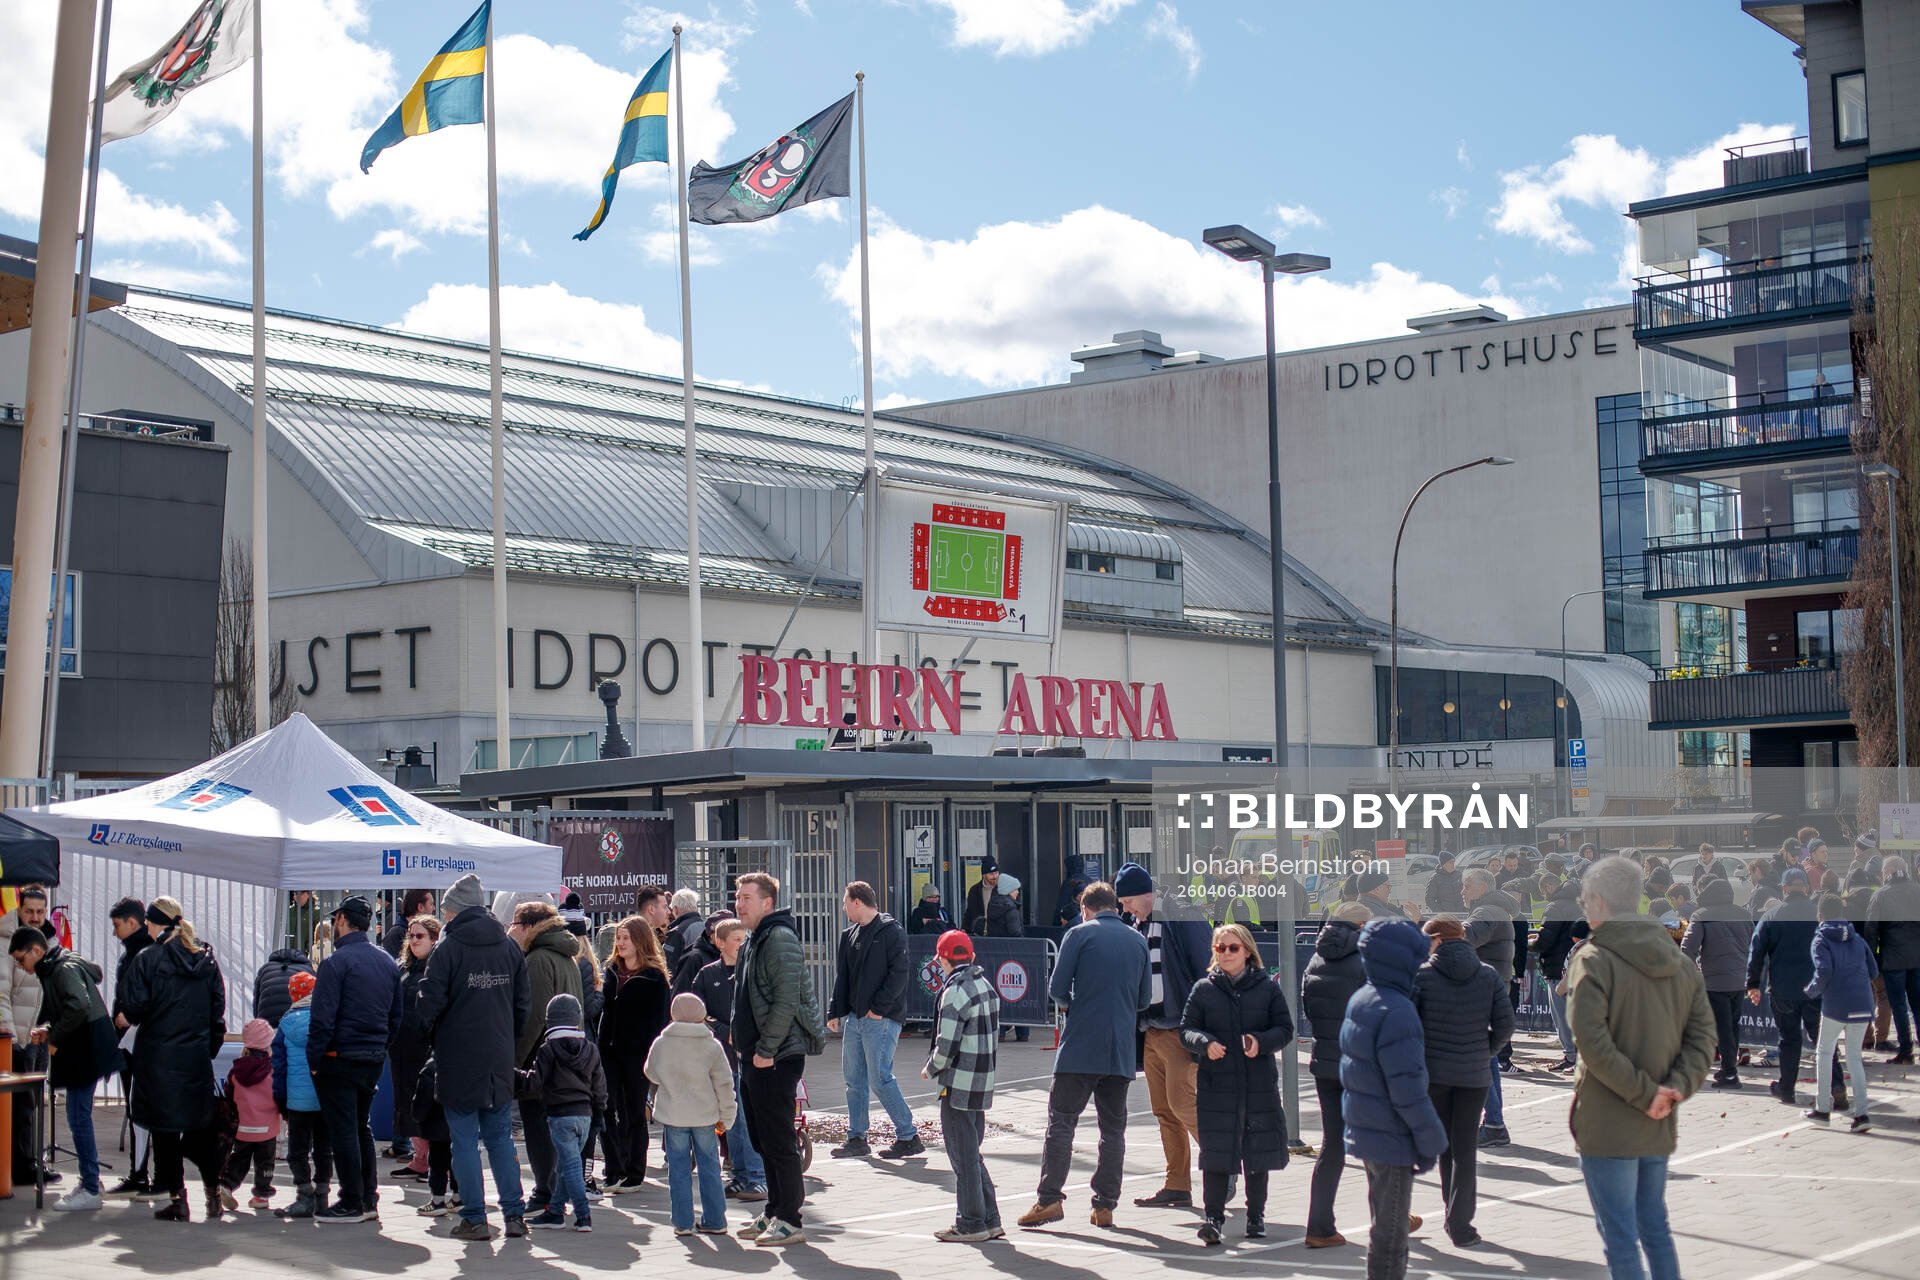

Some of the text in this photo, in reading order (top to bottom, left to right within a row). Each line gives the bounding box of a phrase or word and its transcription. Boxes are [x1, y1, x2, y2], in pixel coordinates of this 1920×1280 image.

[1019, 614, 1026, 632] 1
[737, 653, 1179, 742] BEHRN ARENA
[1386, 742, 1493, 768] ENTRÉ
[1573, 741, 1582, 755] P
[810, 813, 818, 832] 5
[110, 831, 182, 852] LF Bergslagen
[405, 855, 476, 872] LF Bergslagen
[561, 872, 668, 888] NTRÉ NORRA LÄKTAREN
[589, 892, 635, 906] SITTPLATS
